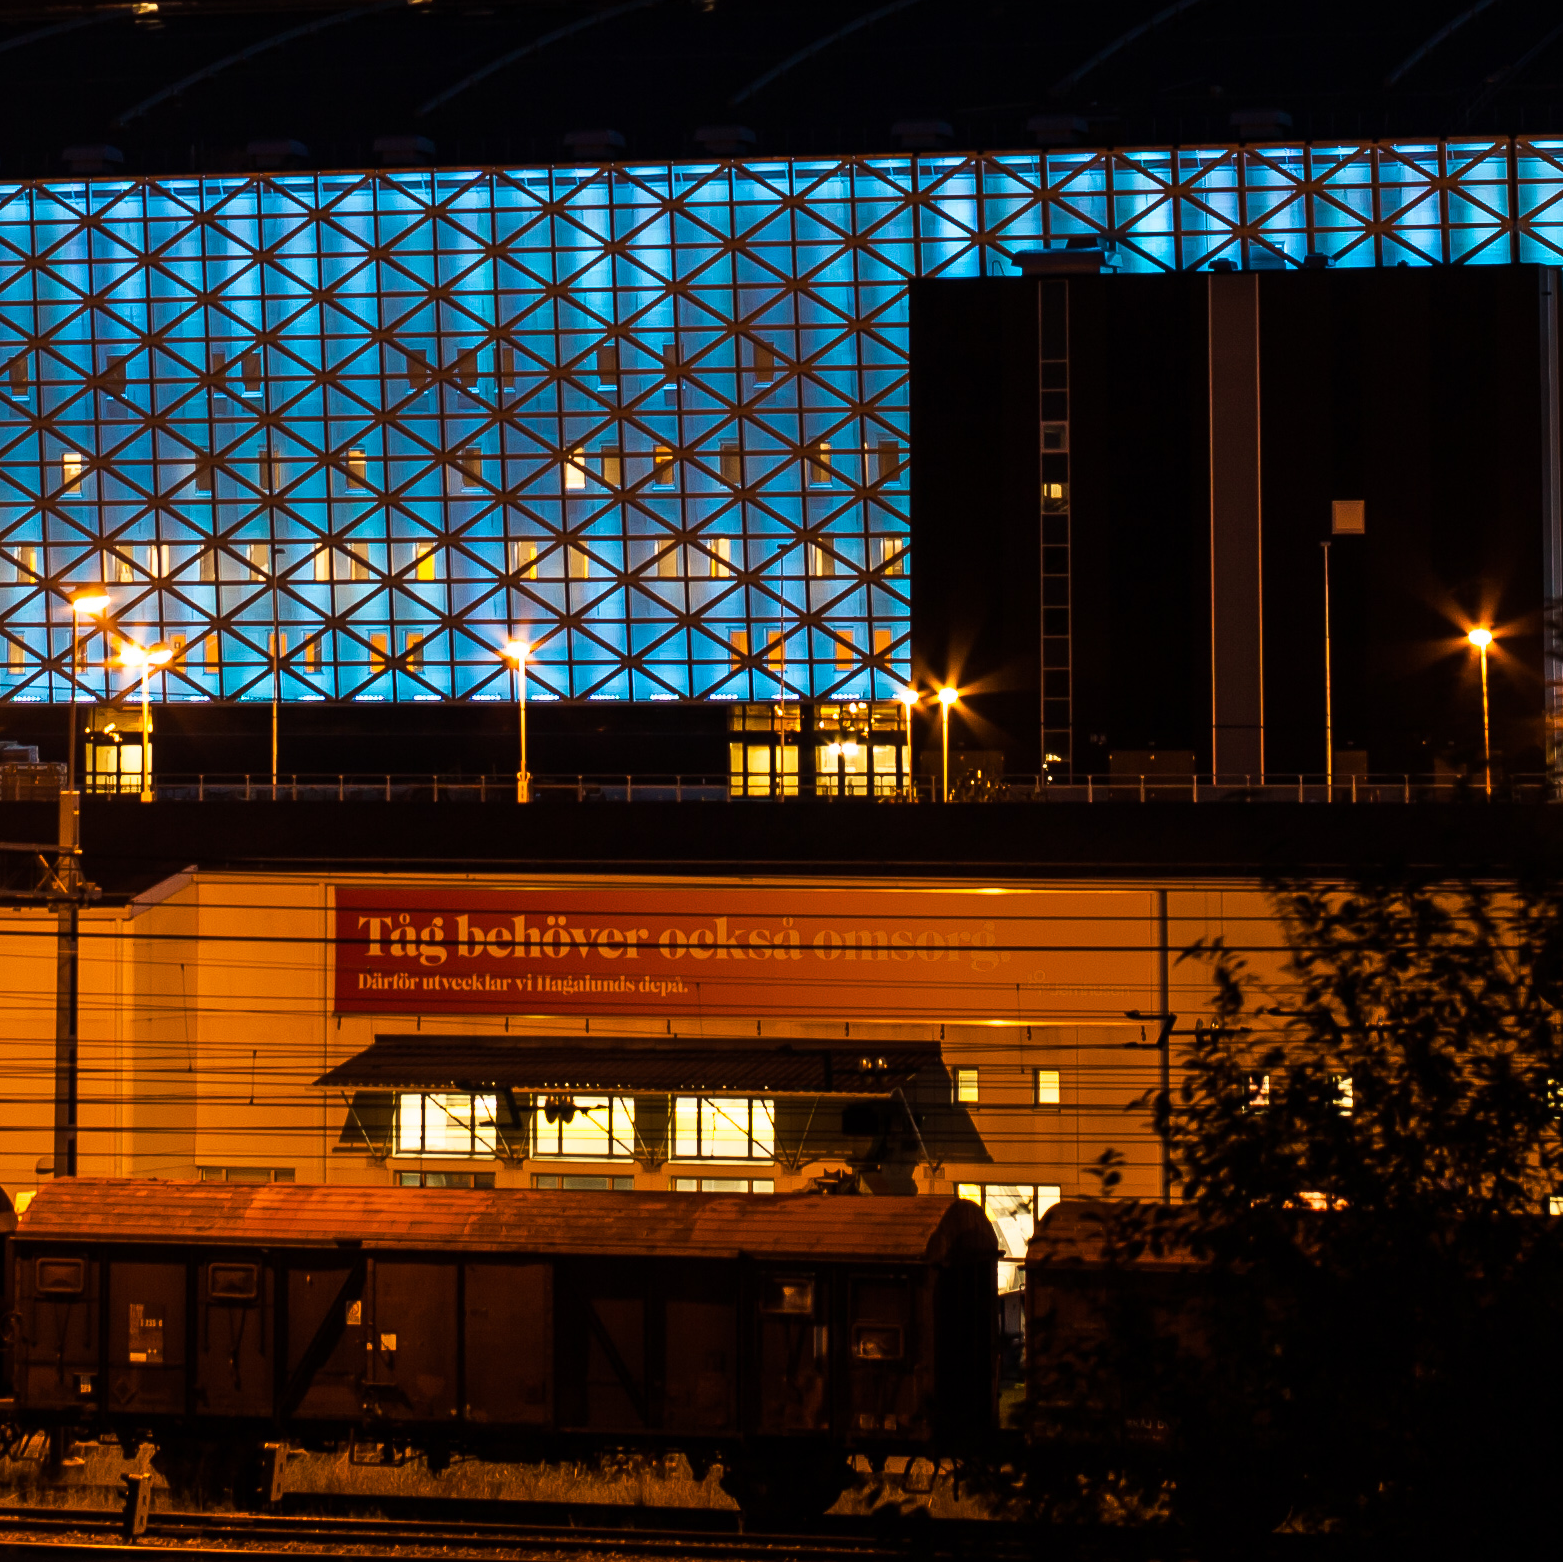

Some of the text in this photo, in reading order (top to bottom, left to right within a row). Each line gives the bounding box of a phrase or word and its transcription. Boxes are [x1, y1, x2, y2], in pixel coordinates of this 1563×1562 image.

[358, 913, 1012, 972] Tåg behöver också omsorg.
[357, 973, 689, 997] Därför utvecklar vi Hagalunds depå.
